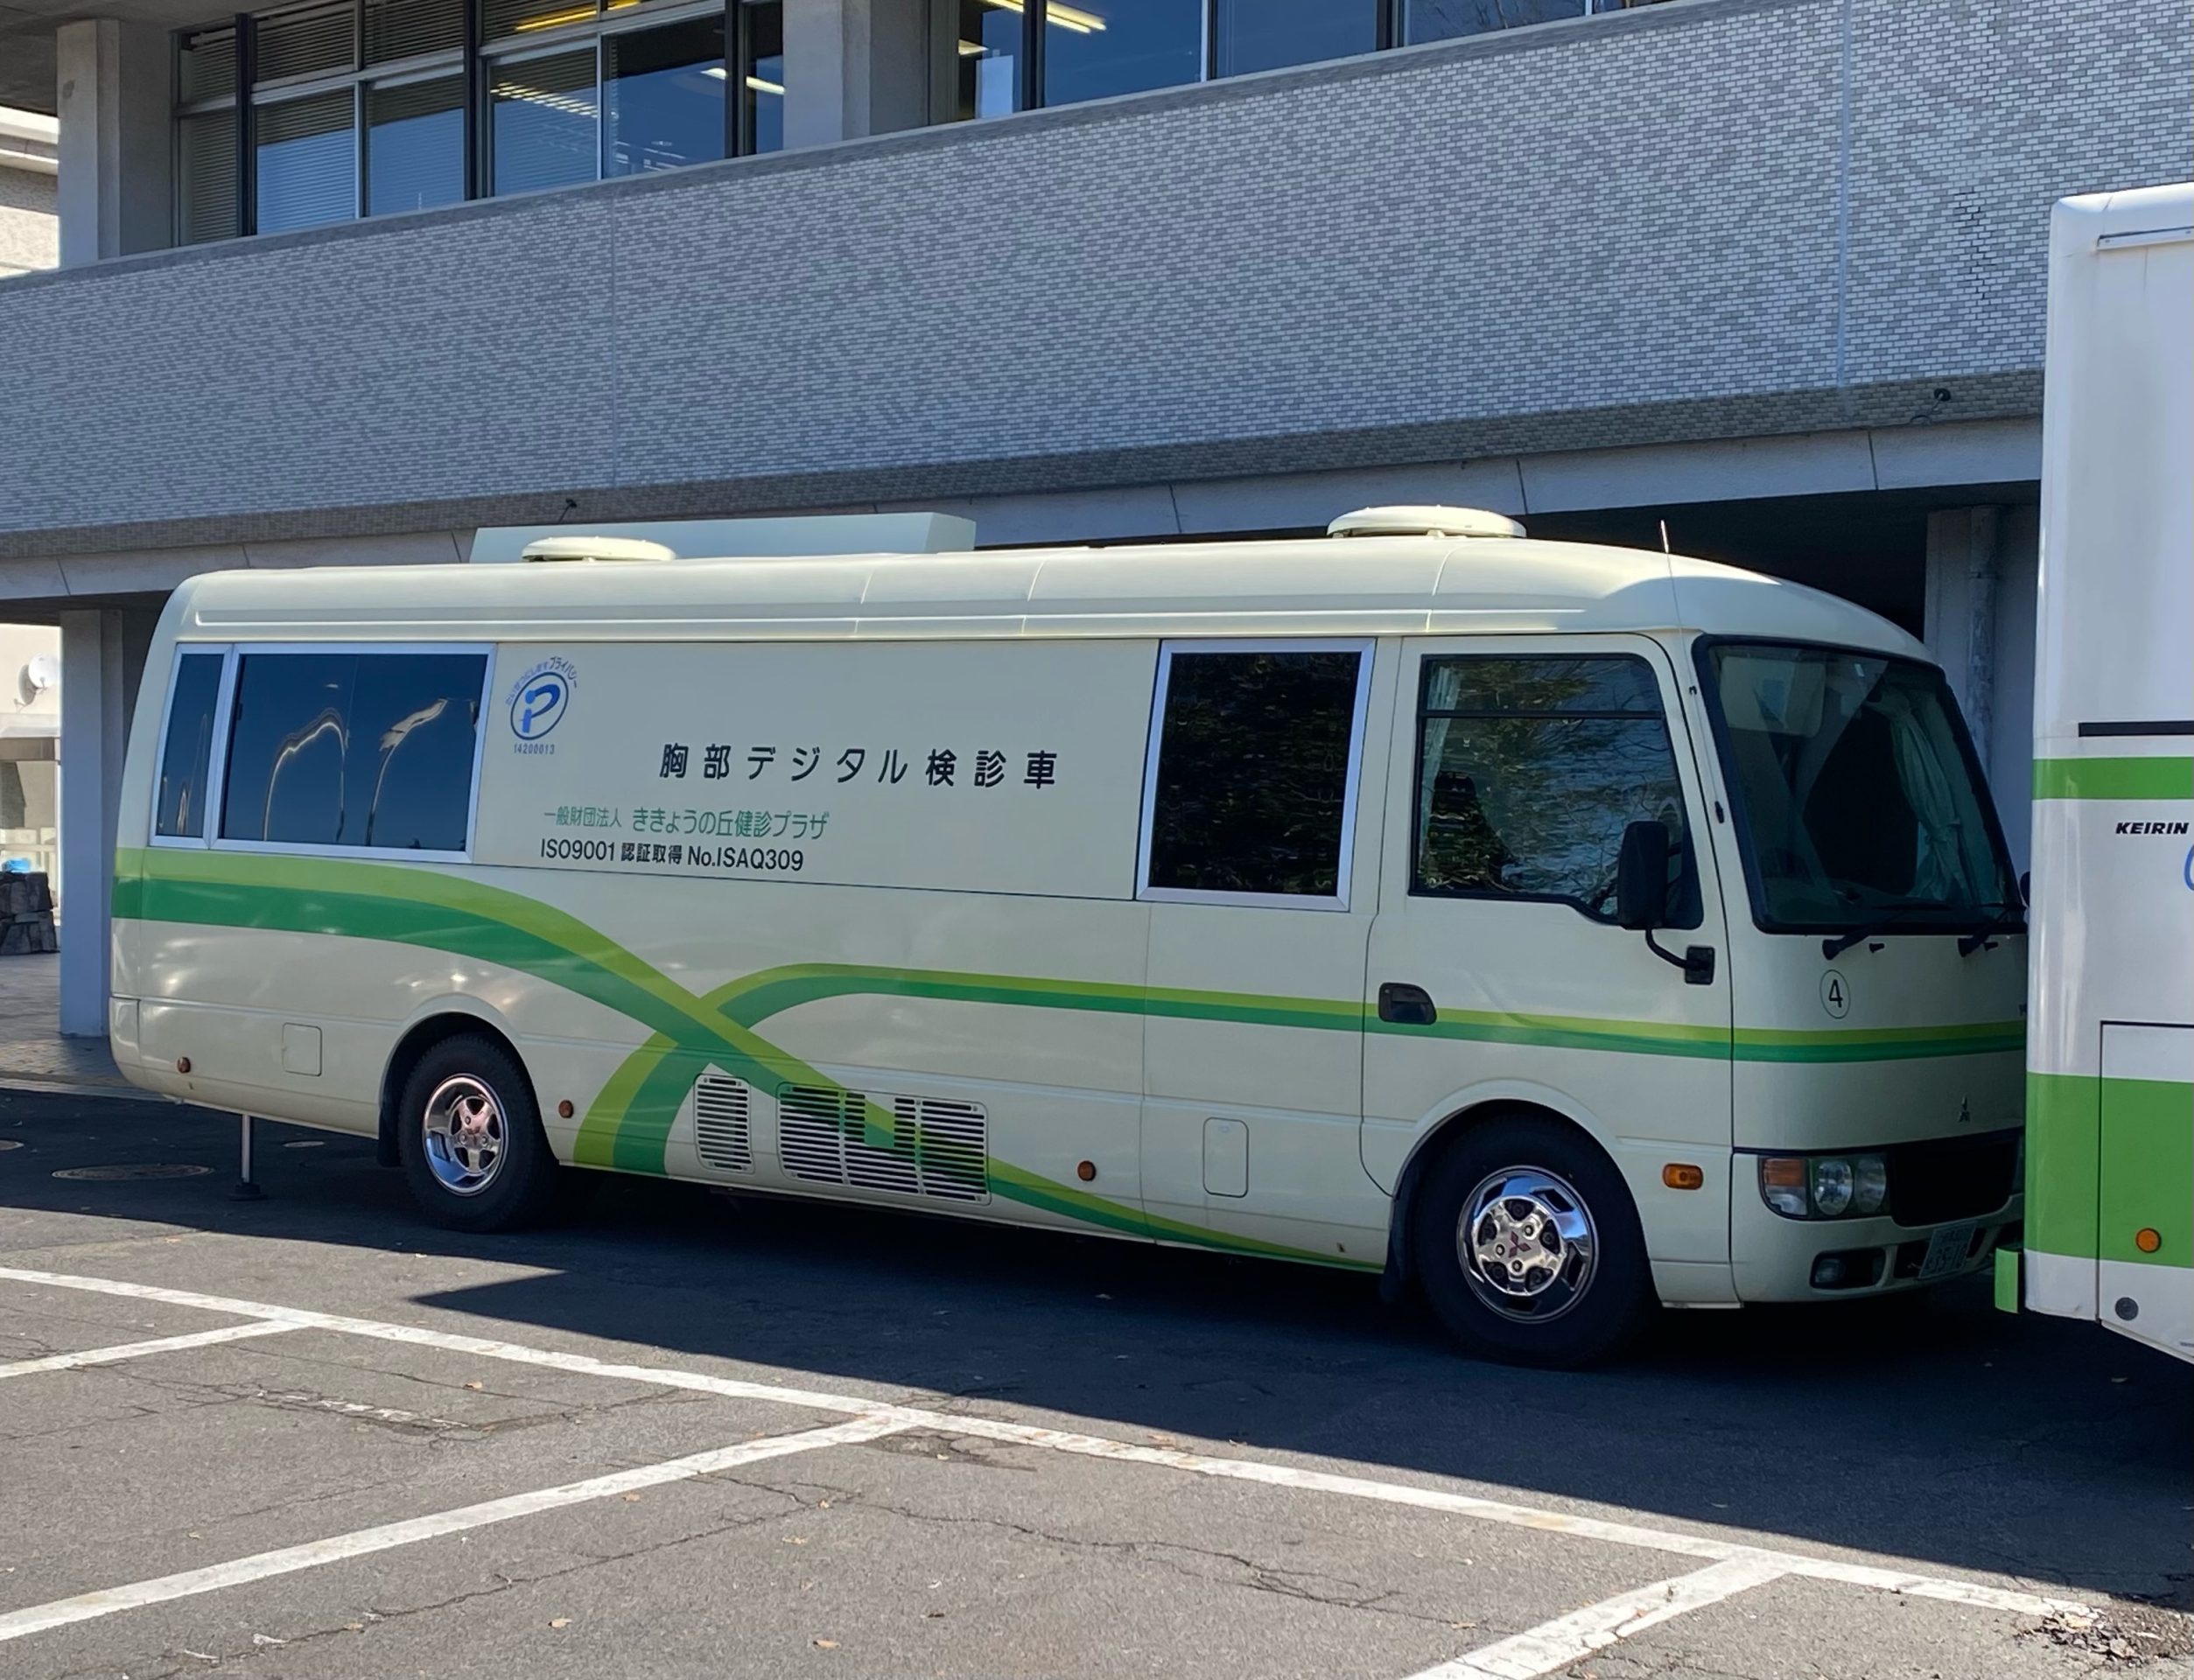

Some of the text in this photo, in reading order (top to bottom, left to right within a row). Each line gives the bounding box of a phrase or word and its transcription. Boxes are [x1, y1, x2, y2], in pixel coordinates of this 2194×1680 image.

[514, 743, 555, 754] 14200013
[659, 743, 1058, 790] 胸部デジタル検診車
[543, 805, 830, 840] 一般財団法人 ききょうの丘健診プラザ
[2114, 822, 2190, 835] KEIRIN
[540, 837, 804, 872] ISO9001 認証取得 No.ISAQ309
[1828, 978, 1844, 1008] 4
